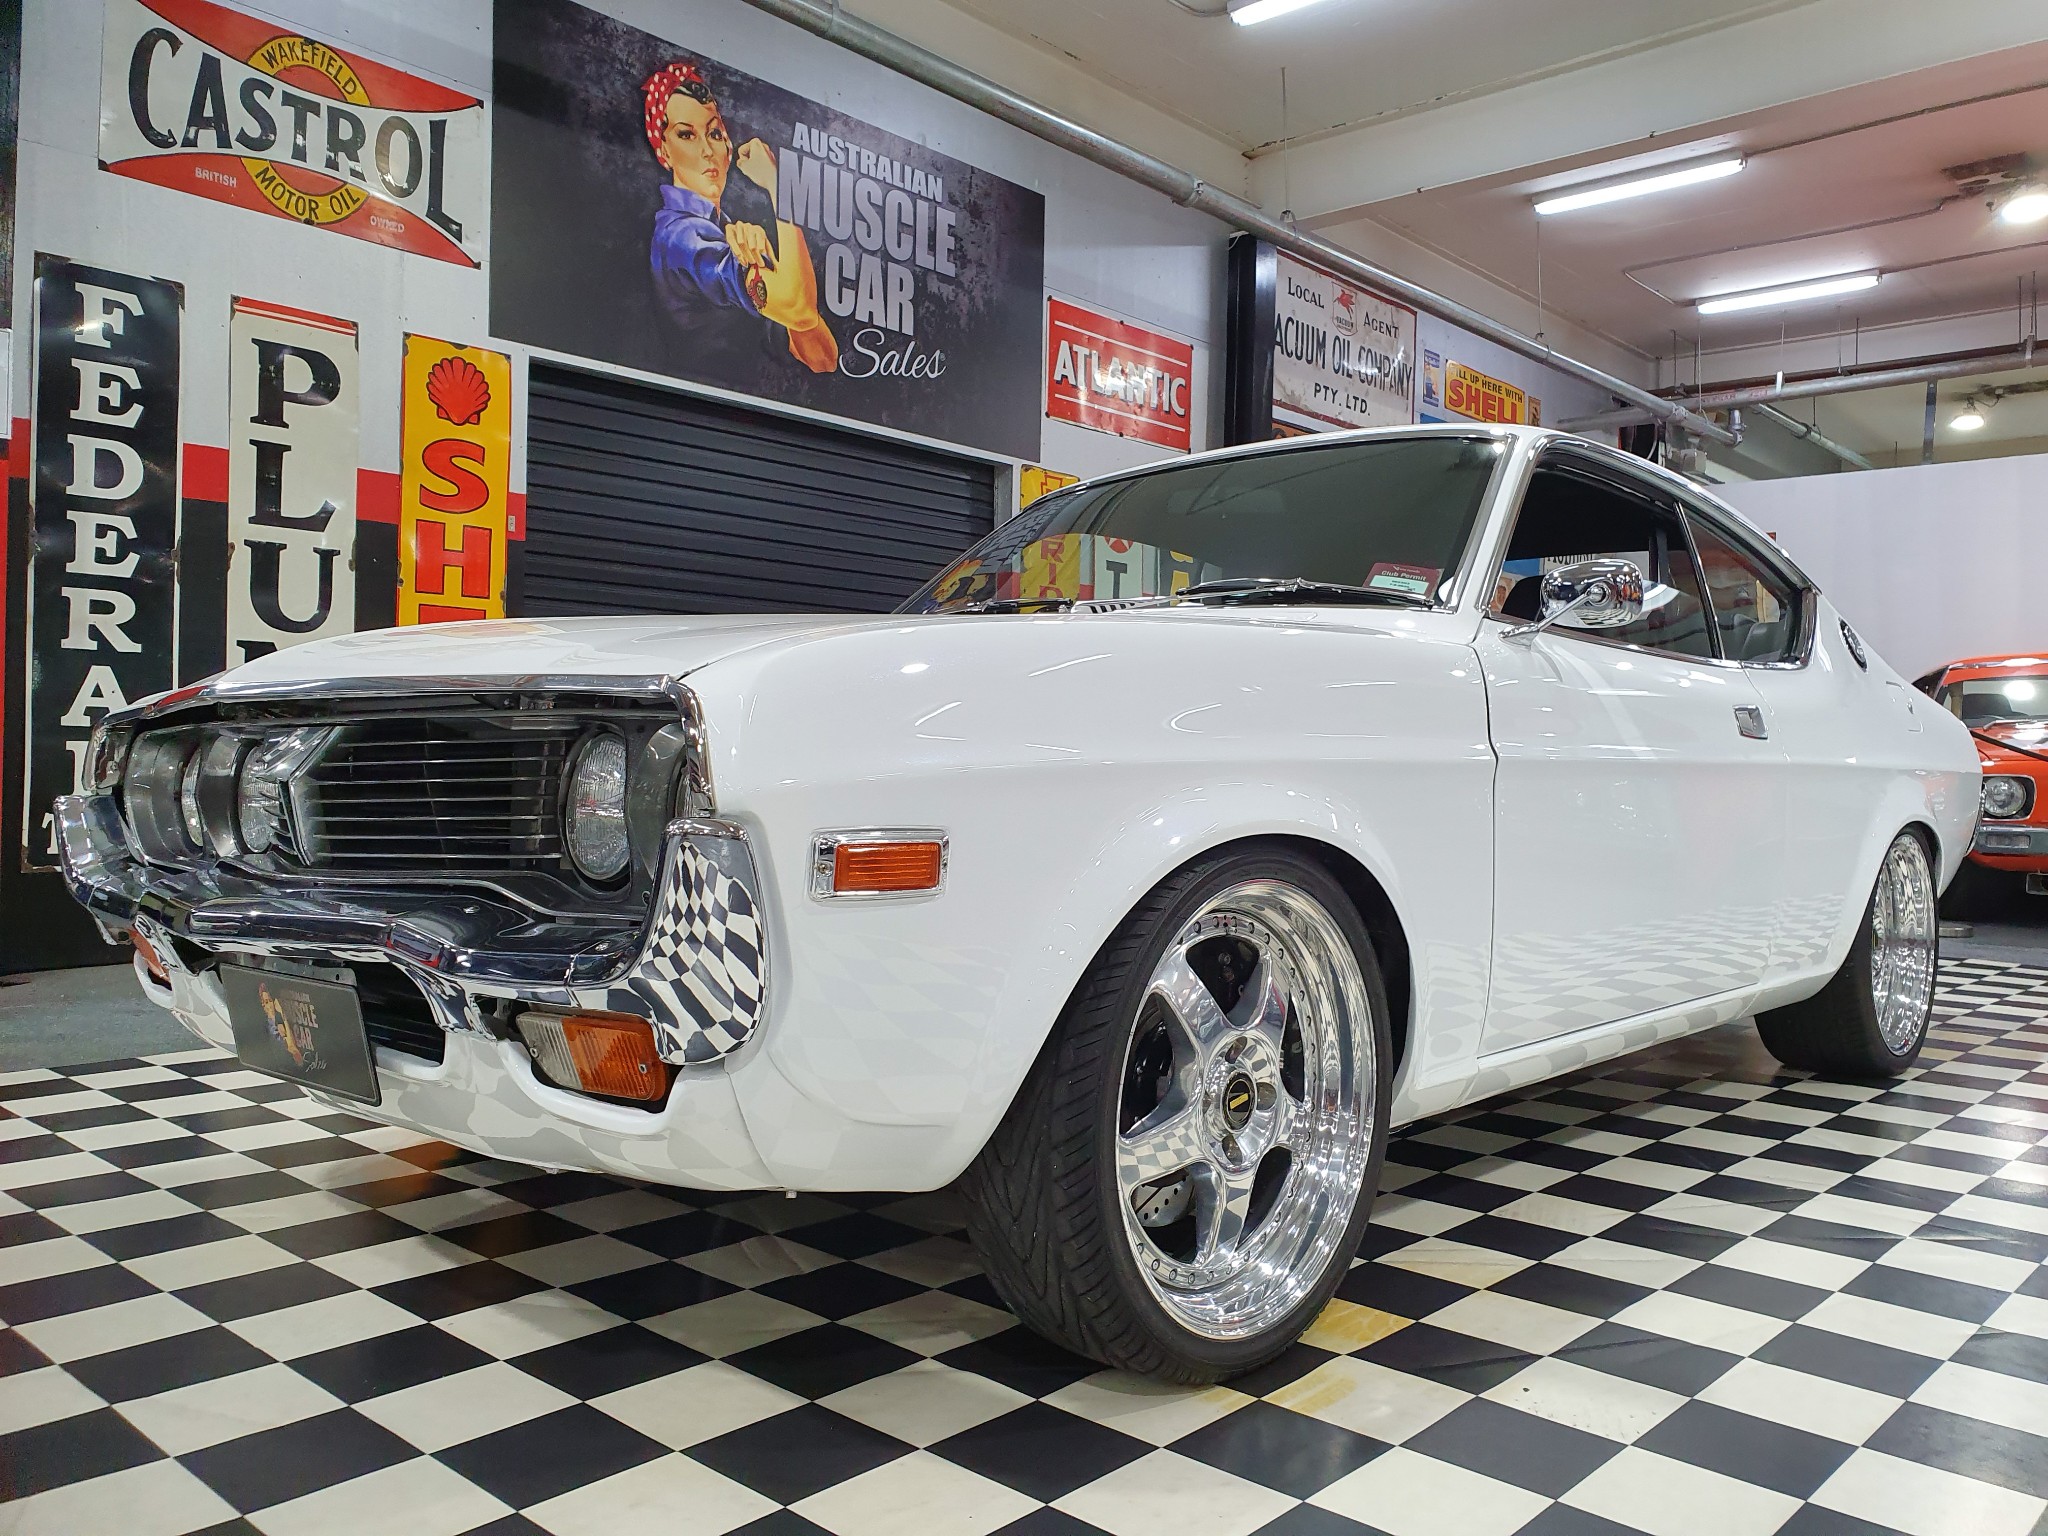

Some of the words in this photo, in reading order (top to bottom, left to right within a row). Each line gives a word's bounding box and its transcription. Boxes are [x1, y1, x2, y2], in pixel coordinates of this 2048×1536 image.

[261, 40, 358, 97] WAKEFIELD
[128, 27, 462, 244] CASTROL
[793, 122, 943, 202] AUSTRALIAN
[195, 166, 237, 188] BRITISH
[255, 166, 319, 220] MOTOR
[329, 188, 360, 216] OIL
[370, 215, 405, 233] OWNED
[778, 146, 957, 278] MUSCLE
[824, 243, 915, 336] CAR
[1288, 276, 1324, 309] LOCAL
[1363, 311, 1399, 339] AGENT
[838, 328, 946, 379] Sales
[1053, 340, 1186, 416] ATLANTIC
[1274, 313, 1327, 369] ACUUM
[1332, 335, 1353, 379] OIL
[1358, 345, 1412, 401] COMPANY
[1314, 382, 1342, 406] PTY.
[1346, 393, 1371, 416] LTD.
[1451, 367, 1468, 380] ILL
[1470, 373, 1480, 385] UP
[1482, 379, 1503, 395] HERE
[1505, 387, 1523, 403] WITH
[1400, 572, 1427, 581] Permit
